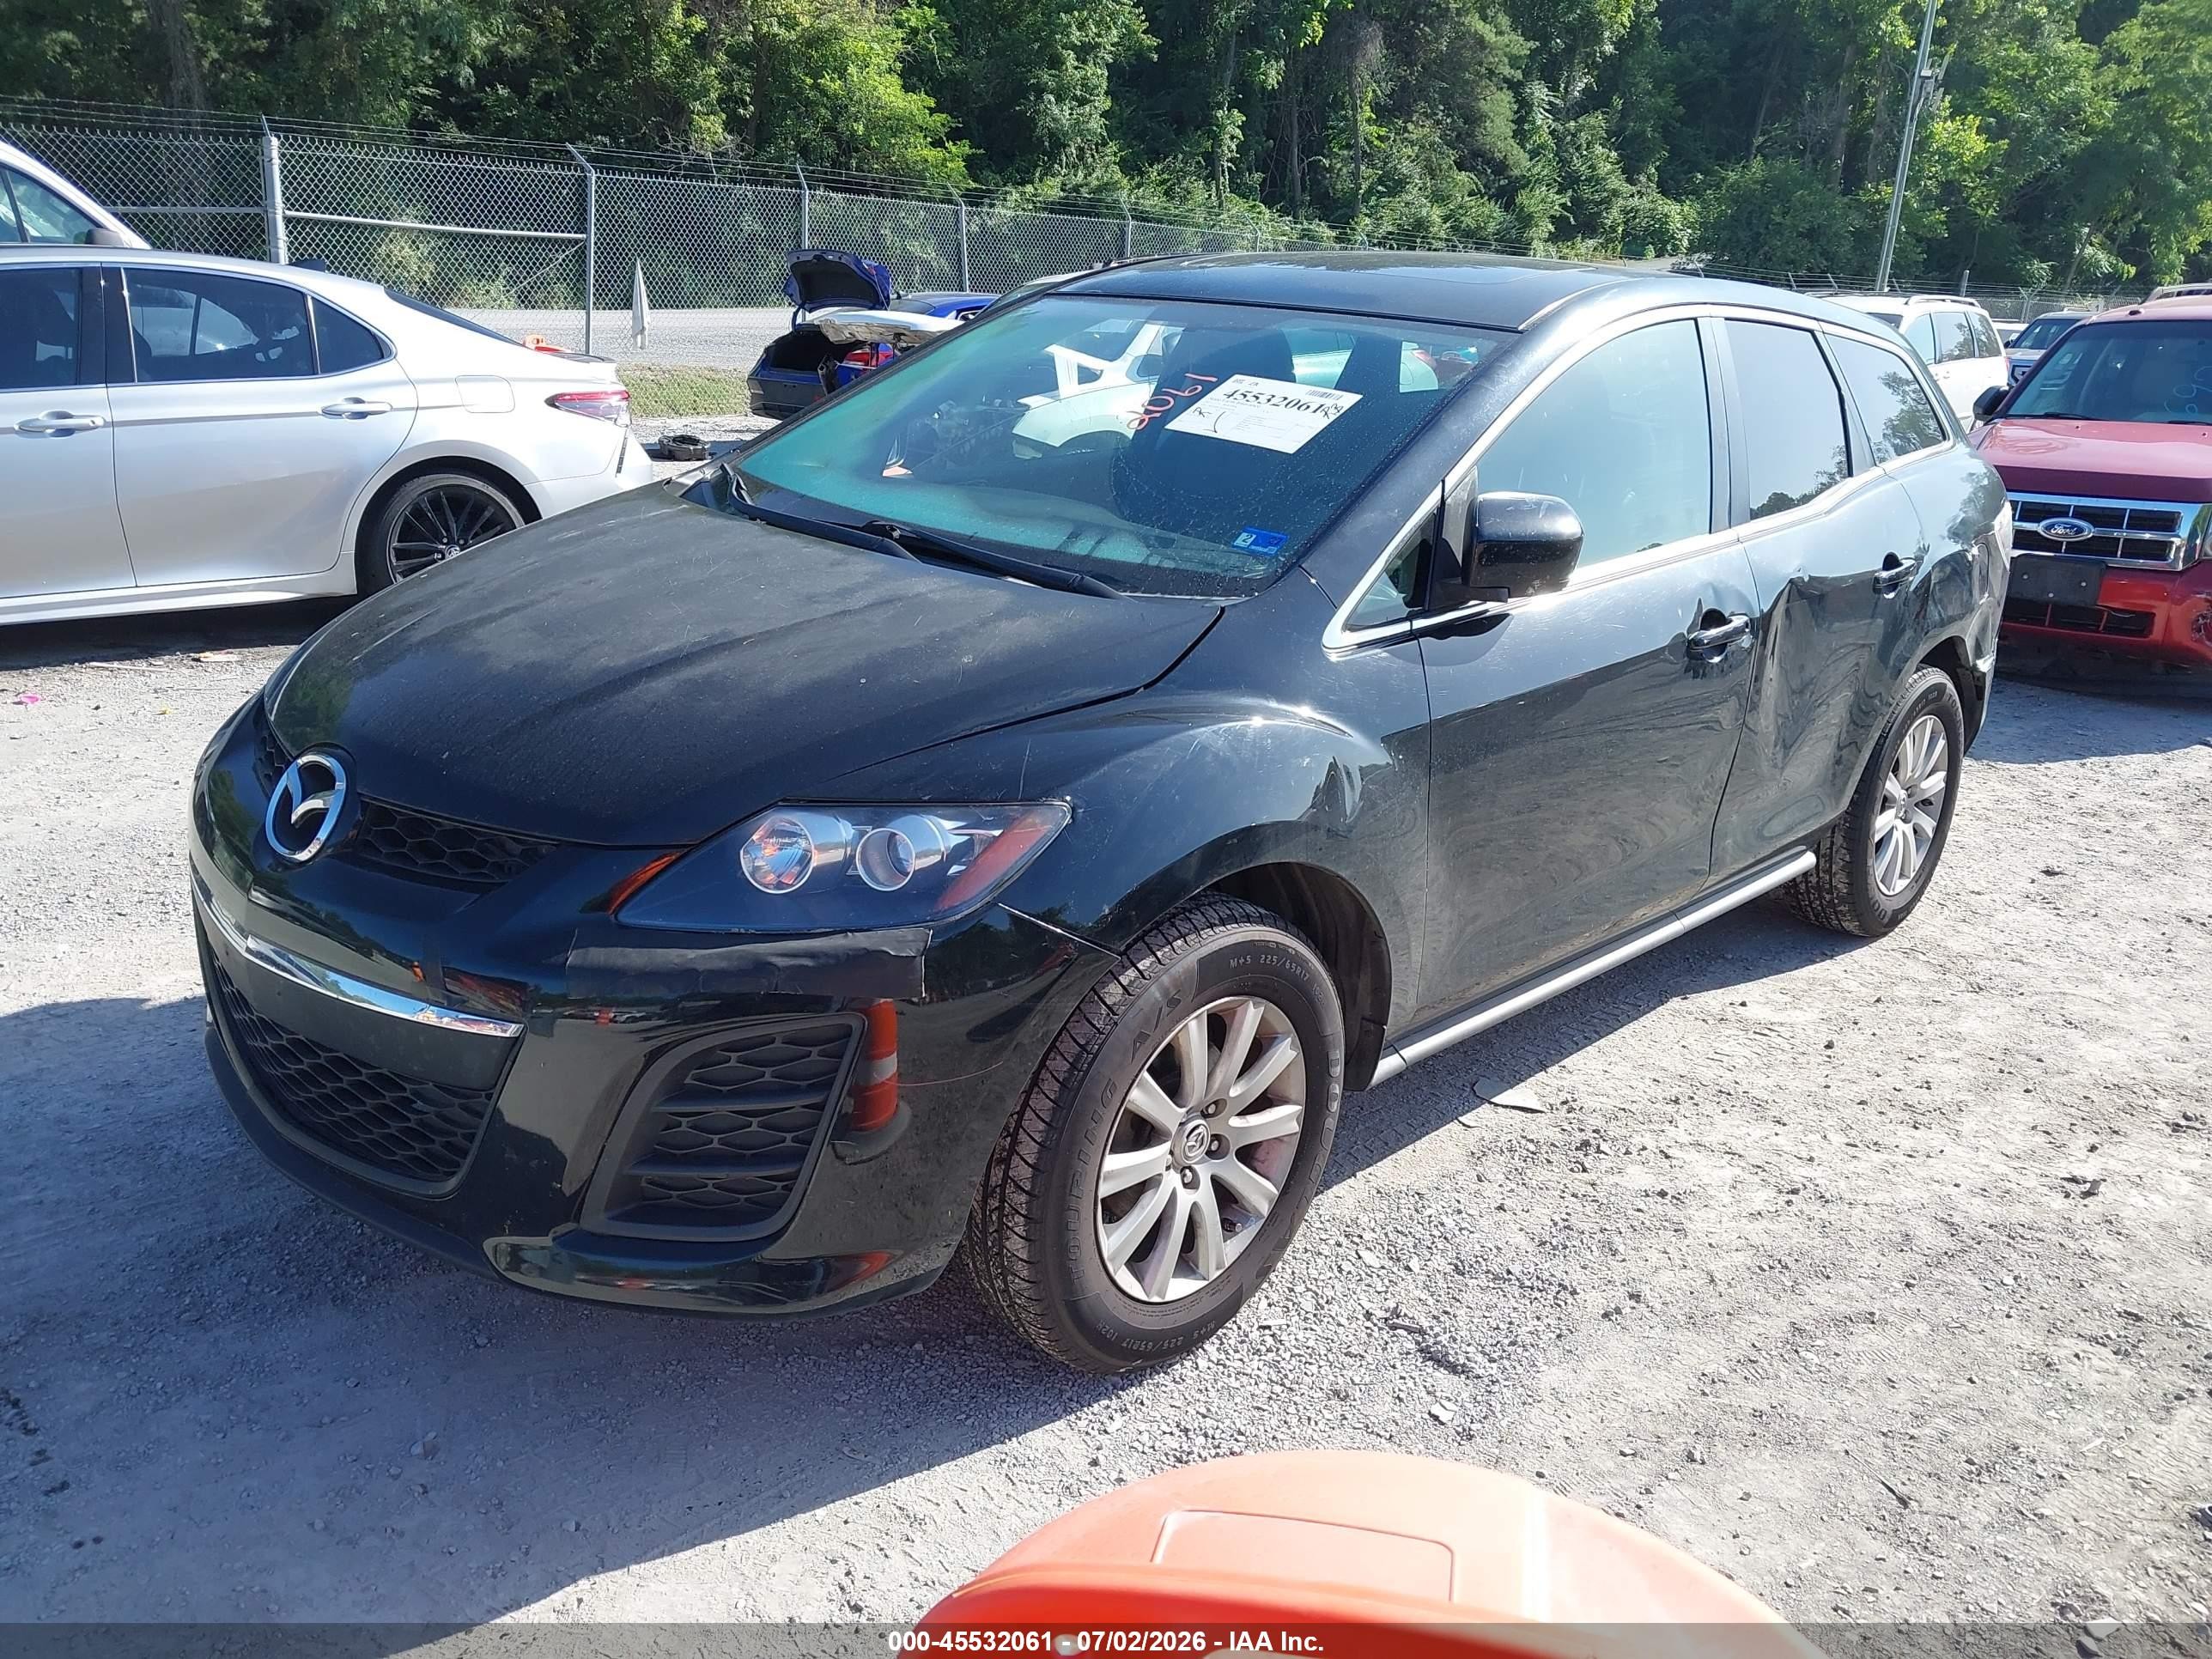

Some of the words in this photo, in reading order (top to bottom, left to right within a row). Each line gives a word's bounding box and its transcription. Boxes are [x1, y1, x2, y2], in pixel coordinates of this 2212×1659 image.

[1127, 373, 1218, 430] 2061
[1224, 389, 1324, 413] 45532061
[1242, 534, 1253, 544] 2
[2051, 523, 2077, 536] Ford
[1230, 955, 1251, 969] M+S
[1260, 954, 1310, 981] 225/65R17
[1130, 988, 1182, 1064] A/S
